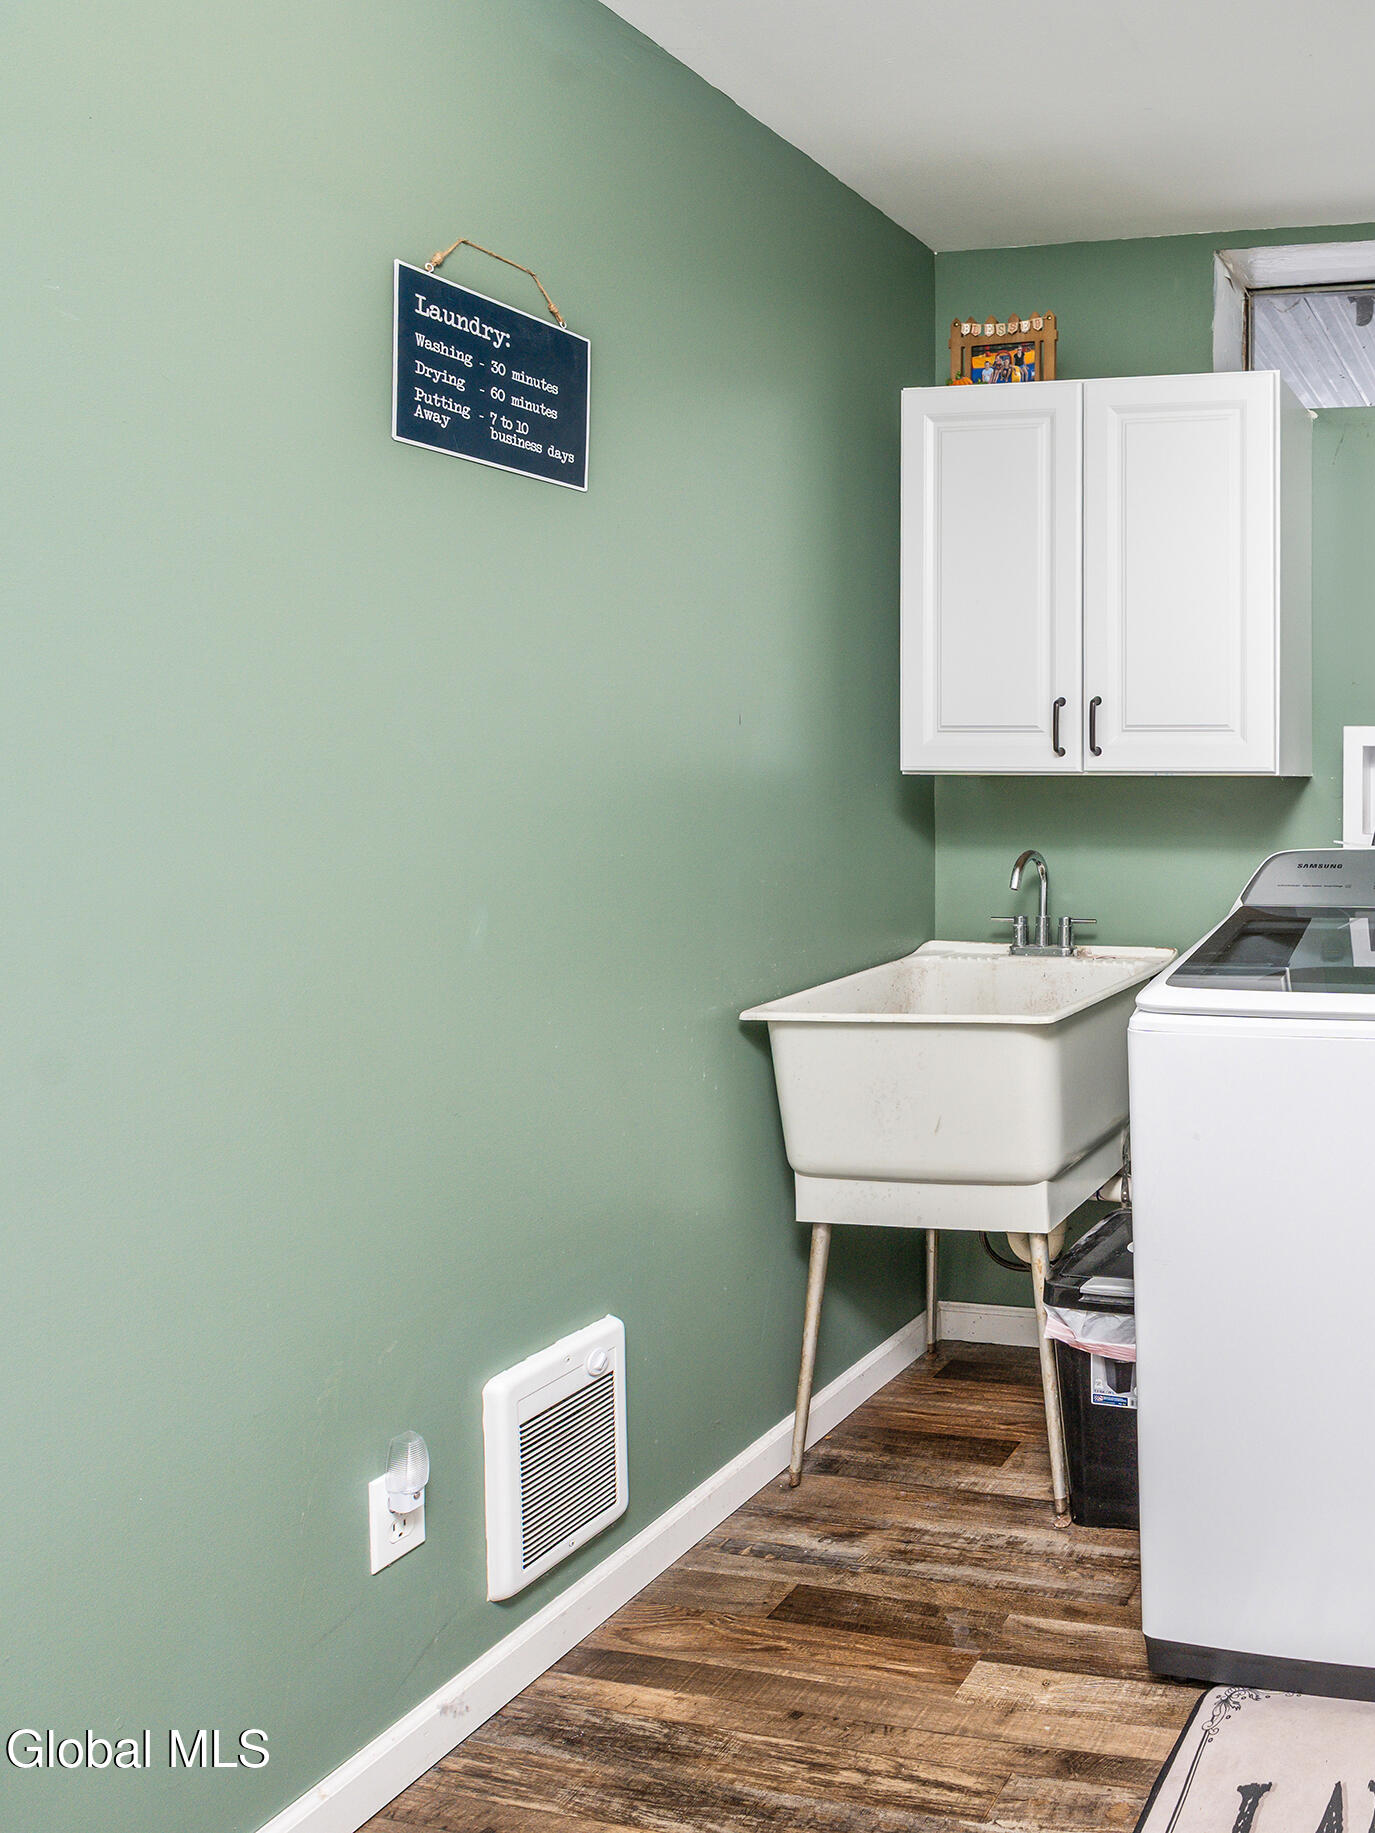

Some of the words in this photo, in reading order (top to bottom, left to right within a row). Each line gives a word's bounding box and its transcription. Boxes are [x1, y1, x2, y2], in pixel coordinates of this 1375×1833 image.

[414, 293, 511, 349] Laundry:
[414, 331, 474, 368] Washing
[490, 359, 507, 377] 30
[511, 370, 559, 395] minutes
[413, 386, 471, 420] Putting
[489, 411, 498, 426] 7
[499, 415, 514, 431] to
[515, 419, 530, 435] 10
[414, 359, 466, 392] Drying
[490, 386, 506, 402] 60
[510, 395, 558, 420] minutes
[413, 404, 452, 429] Away
[489, 426, 543, 454] business
[547, 445, 575, 464] days
